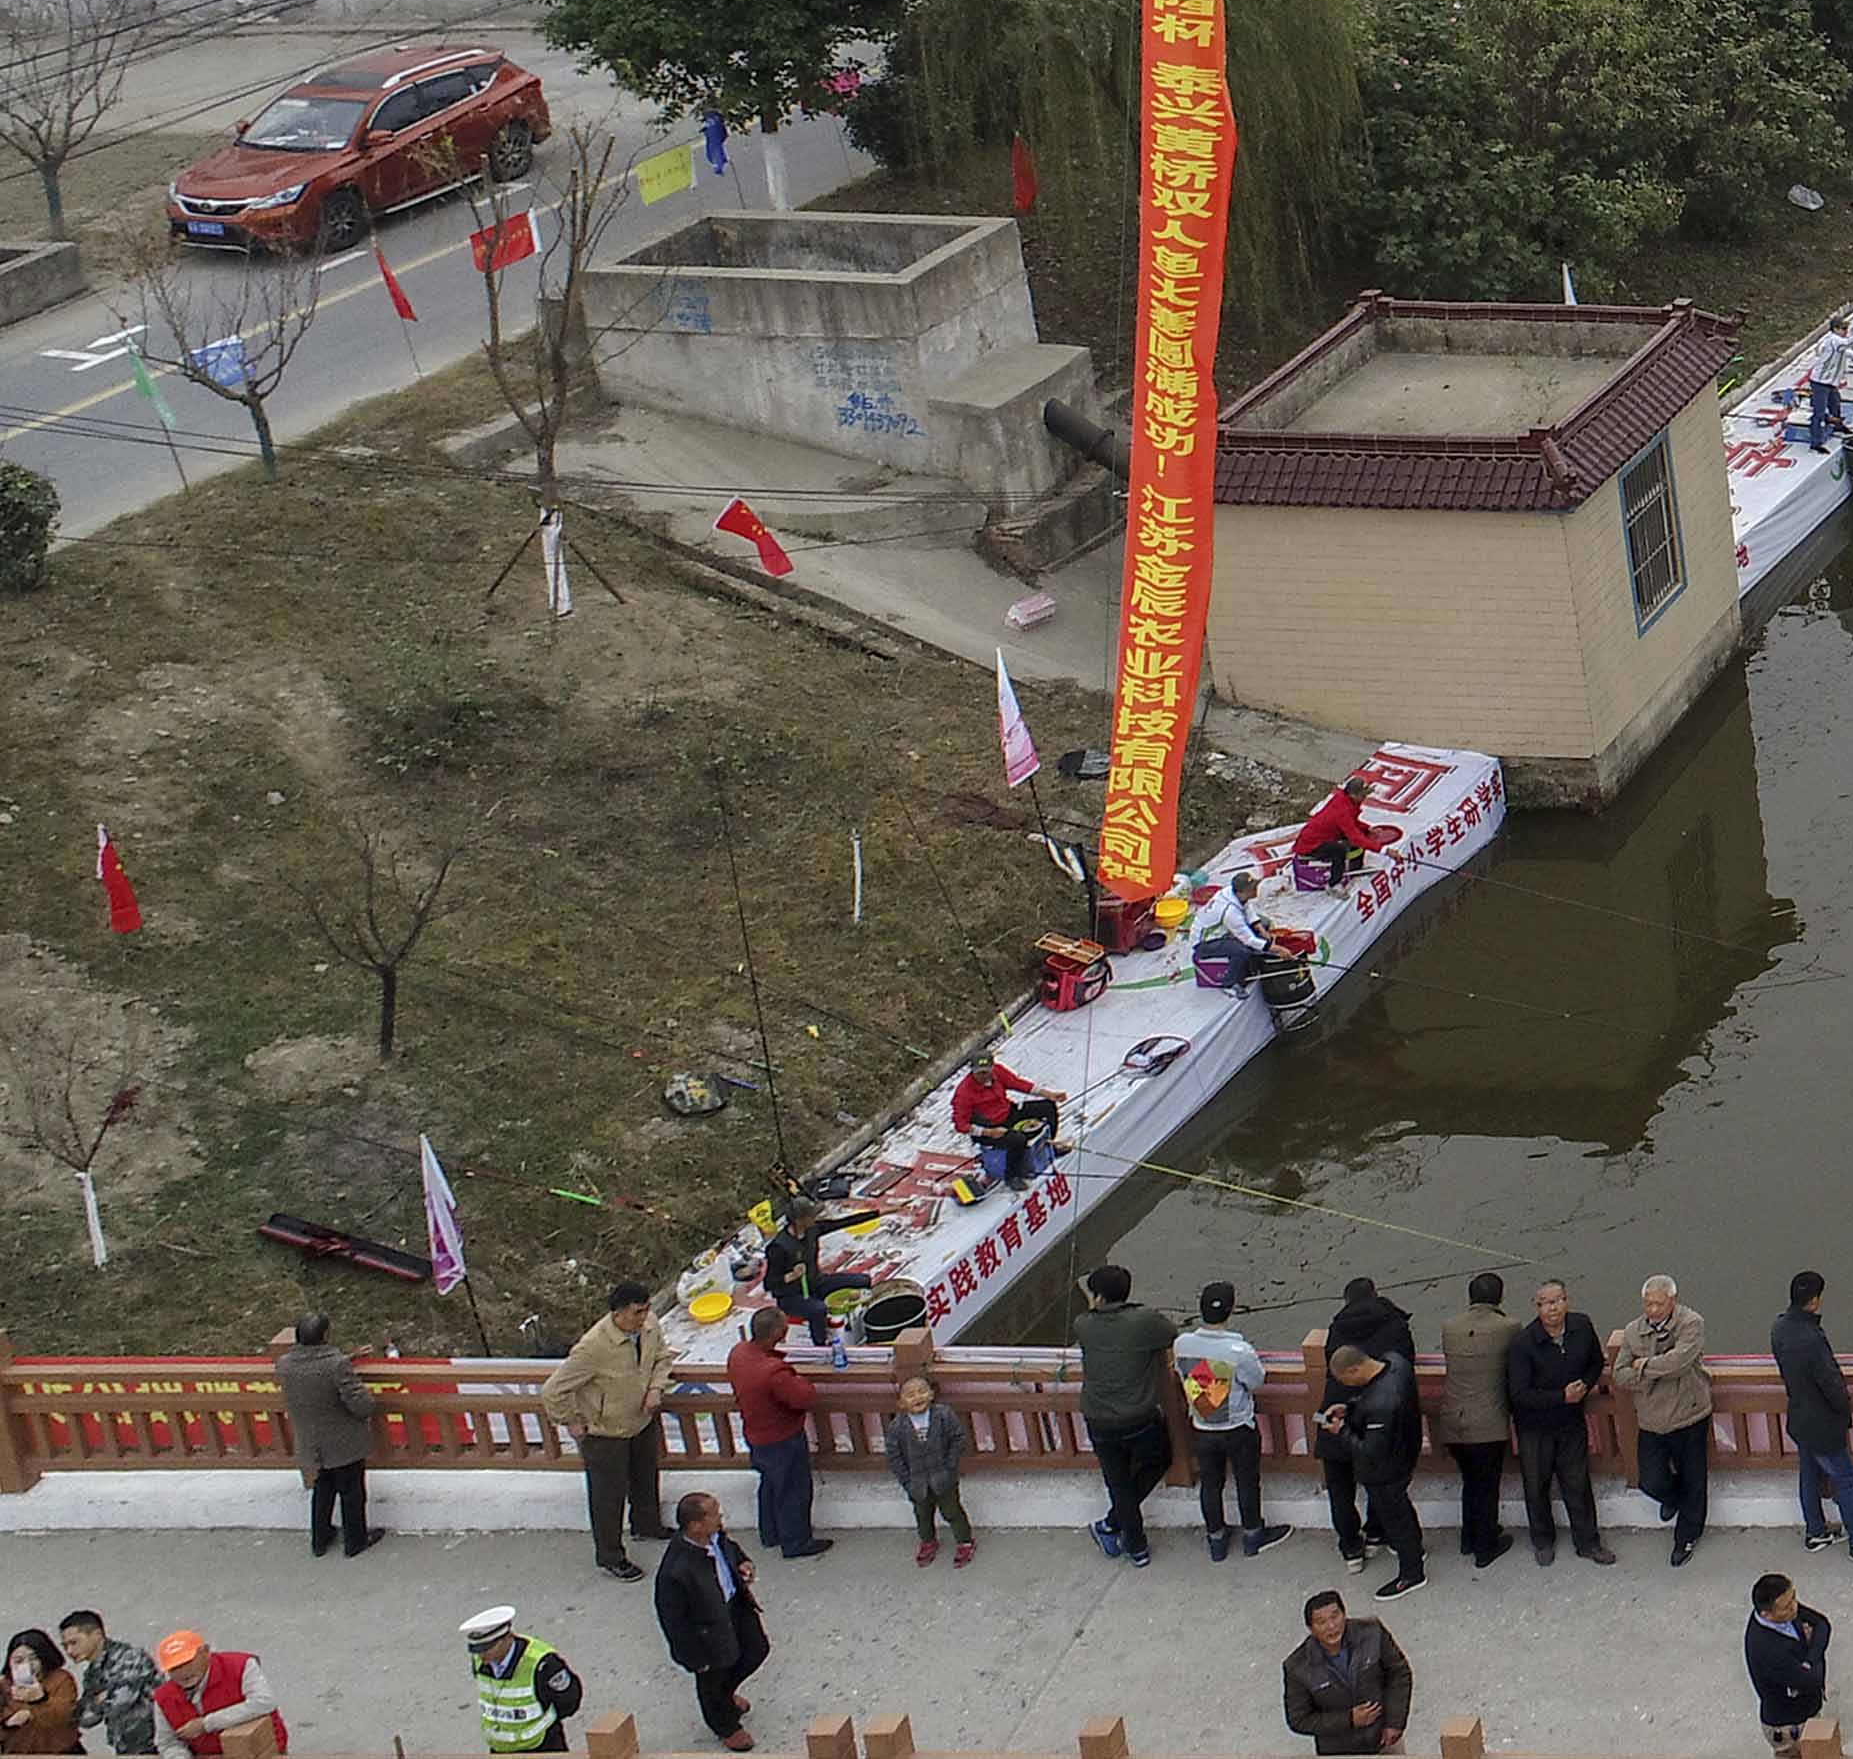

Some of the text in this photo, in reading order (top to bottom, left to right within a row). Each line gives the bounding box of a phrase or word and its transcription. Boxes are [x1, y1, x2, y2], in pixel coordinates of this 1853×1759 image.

[926, 1172, 1073, 1329] 实践教育基地
